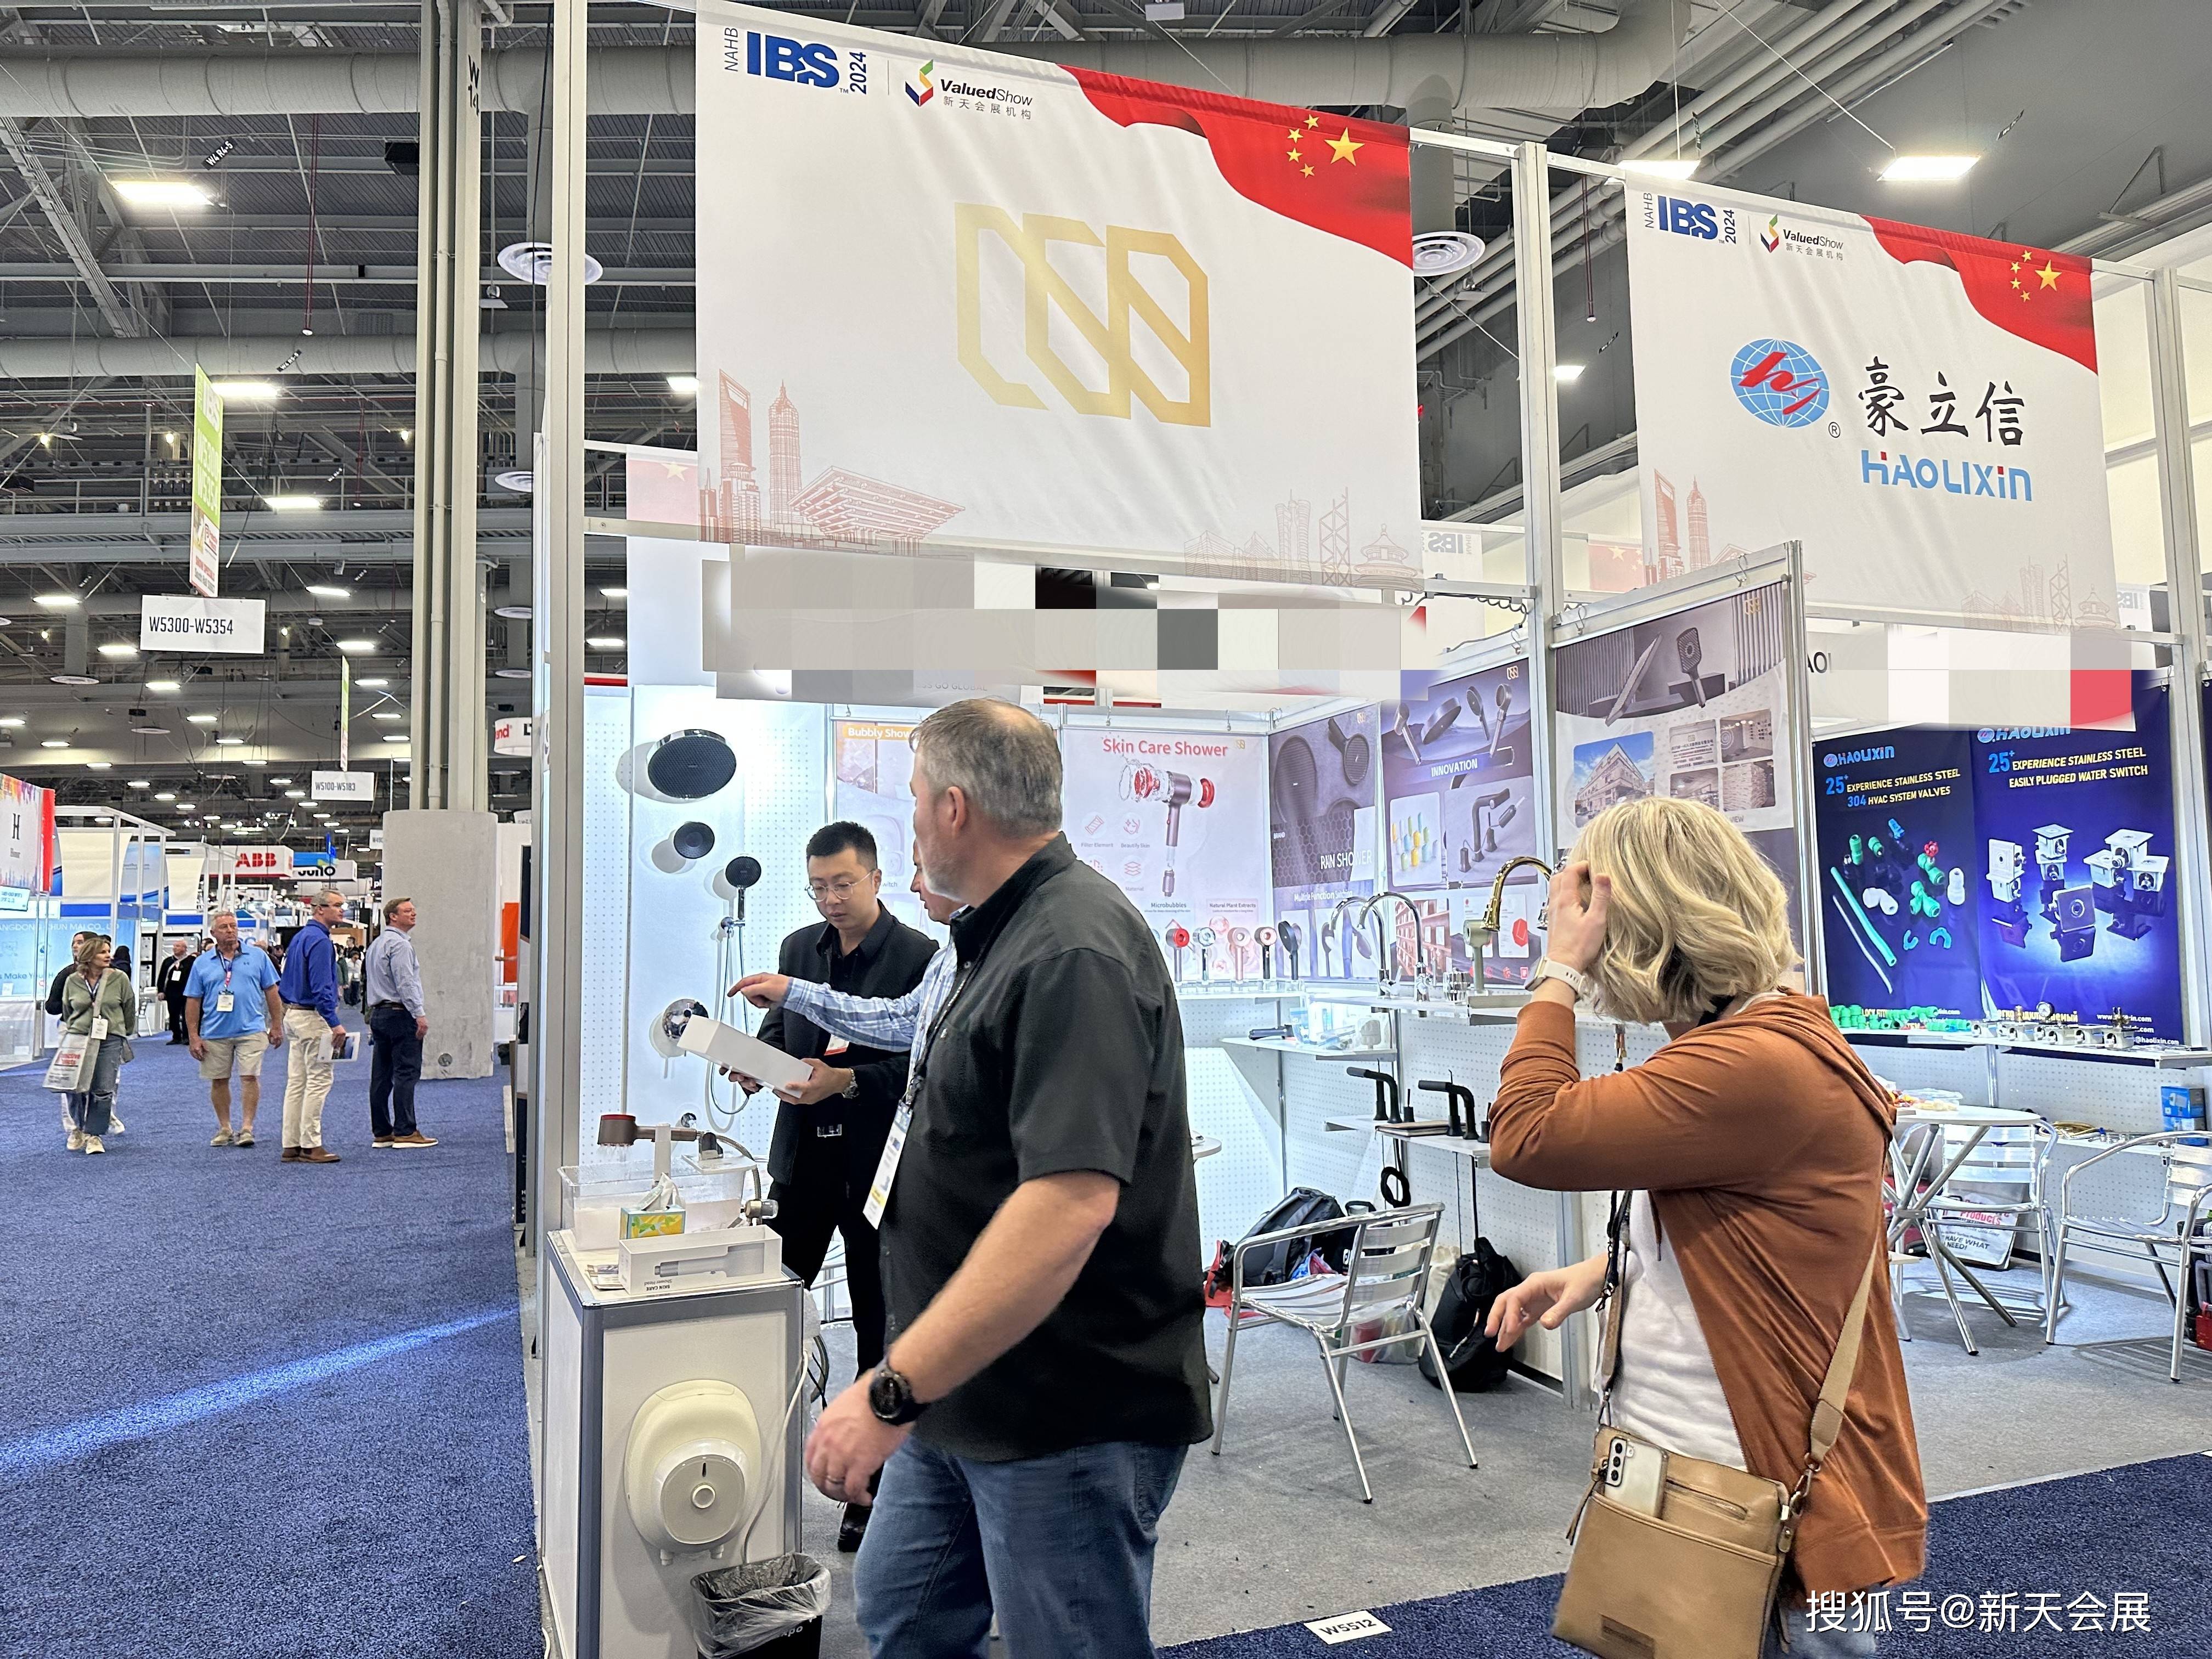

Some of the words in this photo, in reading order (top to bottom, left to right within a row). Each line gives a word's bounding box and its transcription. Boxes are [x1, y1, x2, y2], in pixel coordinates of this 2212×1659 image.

[724, 27, 738, 72] NAHB
[747, 31, 839, 88] IBS
[468, 55, 479, 89] W
[849, 52, 866, 94] 2024
[940, 78, 1032, 106] ValuedShow
[943, 95, 1031, 120] 新天会展机构
[206, 154, 220, 166] W4
[1643, 193, 1654, 229] NAHB
[1657, 195, 1718, 240] IBS
[1723, 210, 1736, 245] 2024
[1783, 229, 1843, 250] ValuedShow
[1786, 242, 1843, 261] 新天会展机构
[1858, 356, 2025, 445] 豪立信
[149, 616, 233, 635] W5300-W5354
[848, 727, 883, 738] Bubbly
[885, 728, 911, 738] Show
[1103, 738, 1133, 753] Skin
[1138, 740, 1171, 754] Care
[1175, 741, 1228, 756] Shower
[1431, 758, 1478, 777] INNOVATION
[2012, 757, 2066, 771] EXPERIENCE
[2068, 750, 2113, 766] STAINLESS
[2115, 747, 2146, 759] STEEL
[1847, 778, 1893, 793] EXPERIENCE
[1894, 772, 1933, 787] STAINLESS
[1934, 768, 1961, 780] STEEL
[2009, 776, 2034, 788] EASILY
[2036, 773, 2076, 785] PLUGGED
[2078, 769, 2107, 782] WATER
[2109, 765, 2148, 778] SWITCH
[1847, 795, 1866, 808] 304
[1868, 795, 1888, 805] HVAC
[1889, 791, 1917, 803] SYSTEM
[1918, 786, 1951, 798] VALVES
[235, 853, 277, 868] ABB
[1336, 850, 1372, 868] SHOWER
[1311, 891, 1335, 900] Function
[1965, 1239, 1990, 1250] WHAT
[1319, 1619, 1377, 1635] W5512
